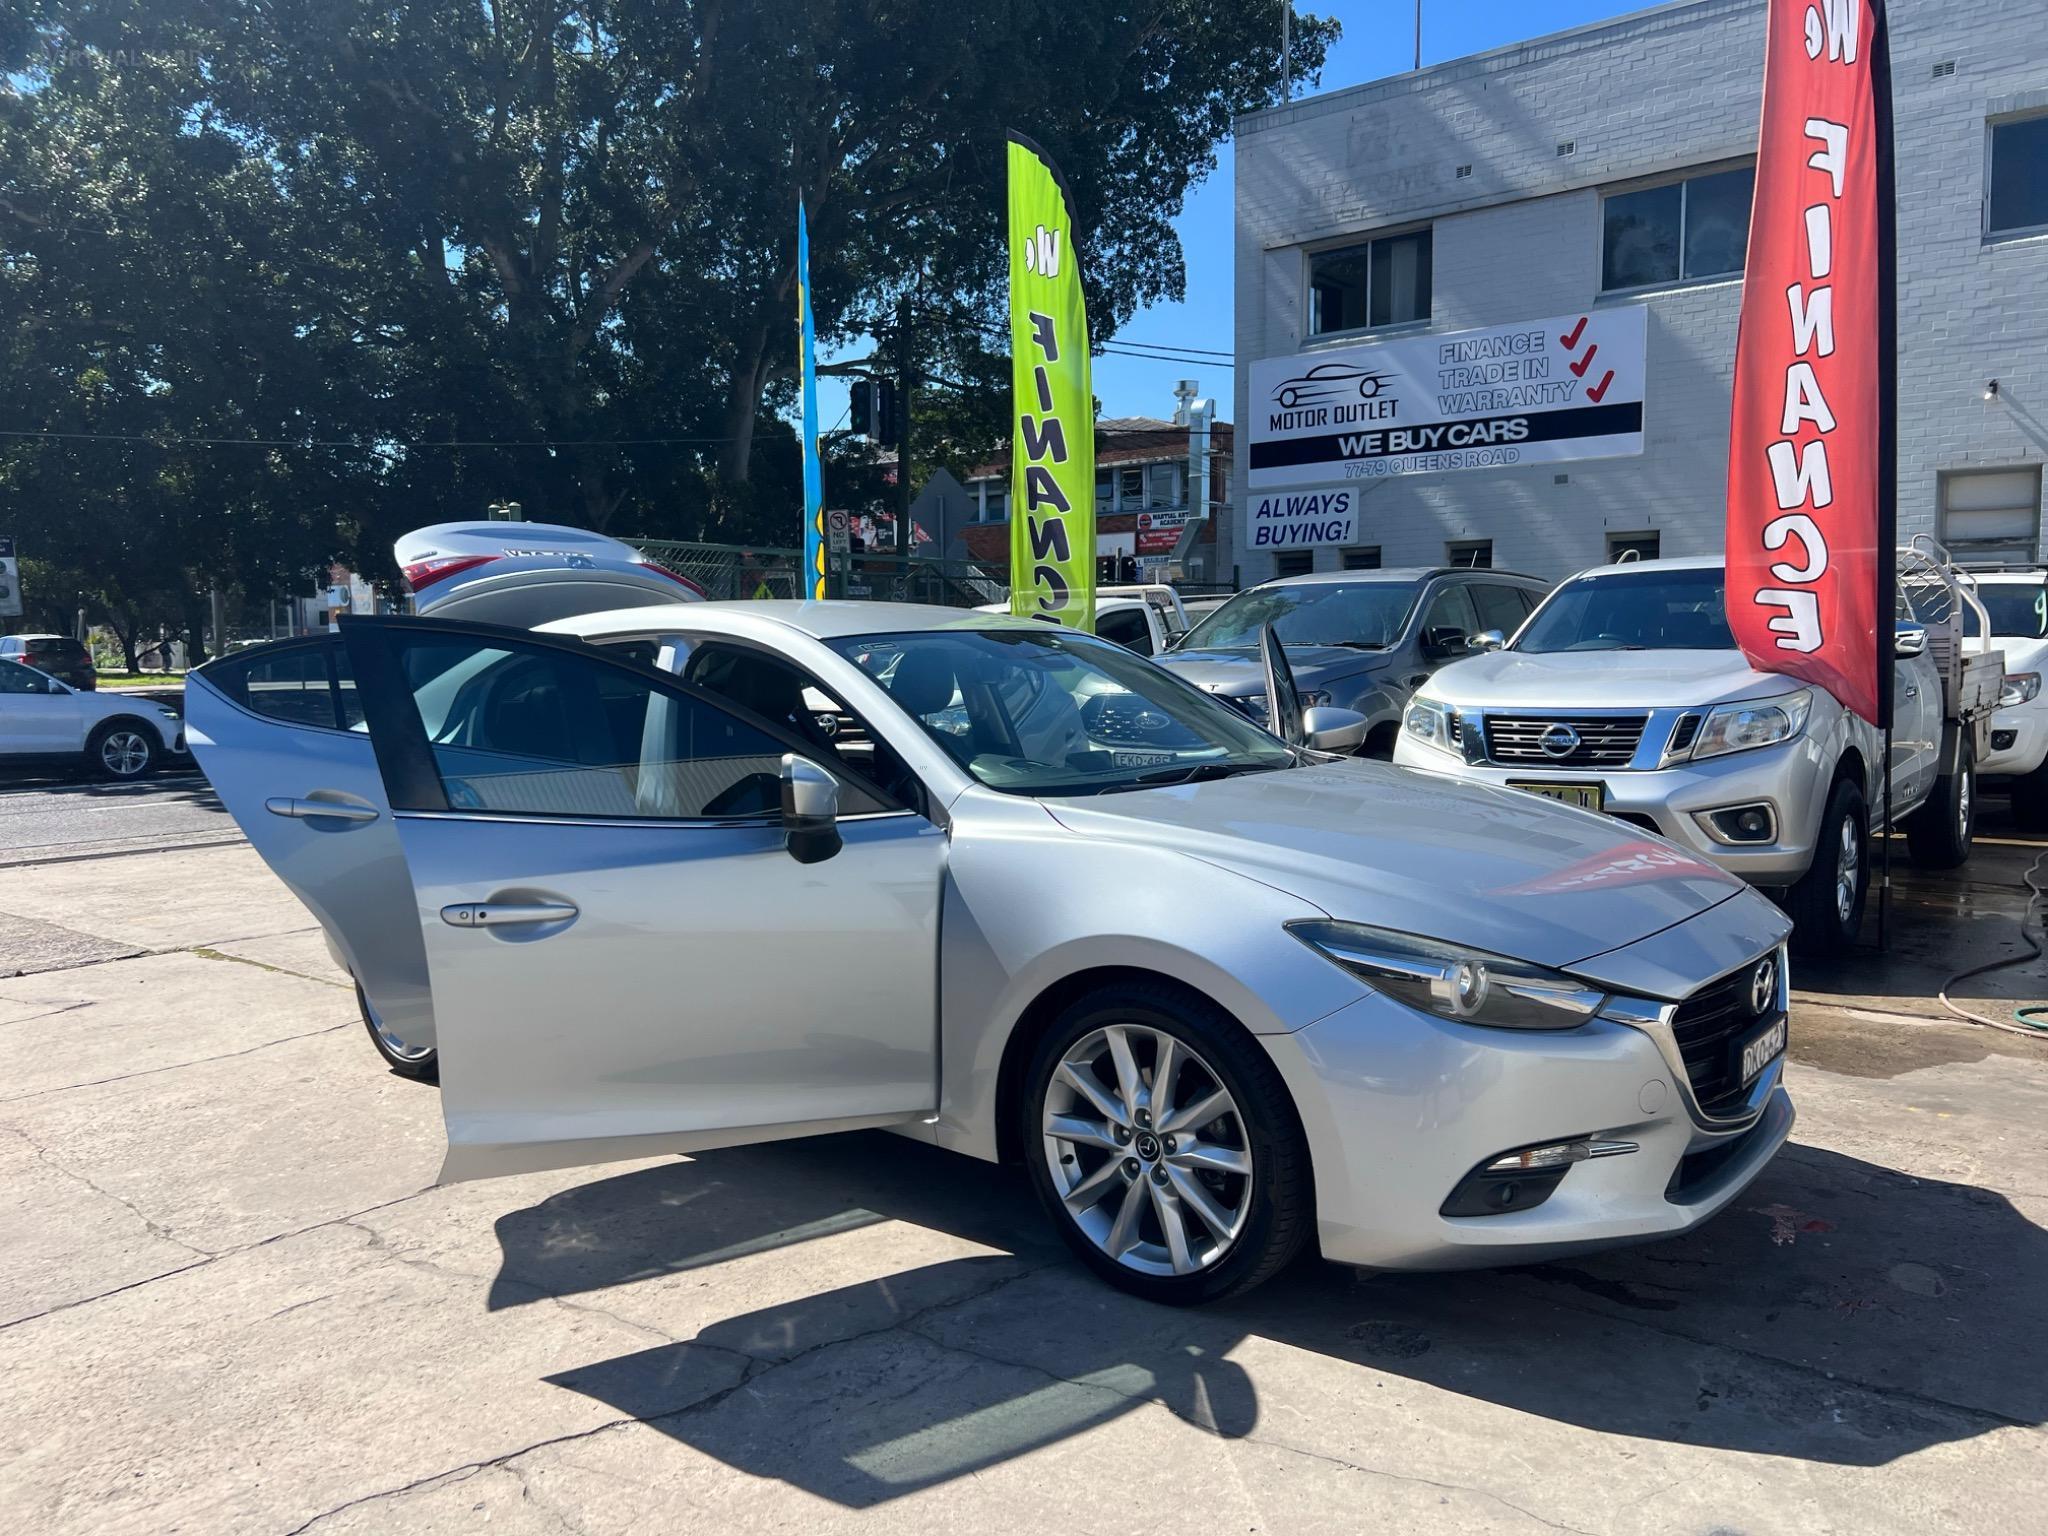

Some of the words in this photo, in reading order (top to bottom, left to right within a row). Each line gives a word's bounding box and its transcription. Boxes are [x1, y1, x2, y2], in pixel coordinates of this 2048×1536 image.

[1439, 331, 1545, 364] FINANCE
[1438, 364, 1518, 389] TRADE
[1523, 357, 1549, 379] IN
[1438, 380, 1578, 415] WARRANTY
[1269, 408, 1328, 431] MOTOR
[1333, 399, 1399, 425] OUTLET
[1338, 433, 1382, 457] WE
[1389, 426, 1445, 452] BUY
[1447, 418, 1529, 446] CARS
[1345, 461, 1387, 478] 77-79
[1390, 453, 1463, 475] QUEENS
[1465, 447, 1519, 467] ROAD
[1256, 492, 1350, 519] ALWAYS
[1255, 520, 1351, 546] BUYING!
[2034, 589, 2047, 635] 9
